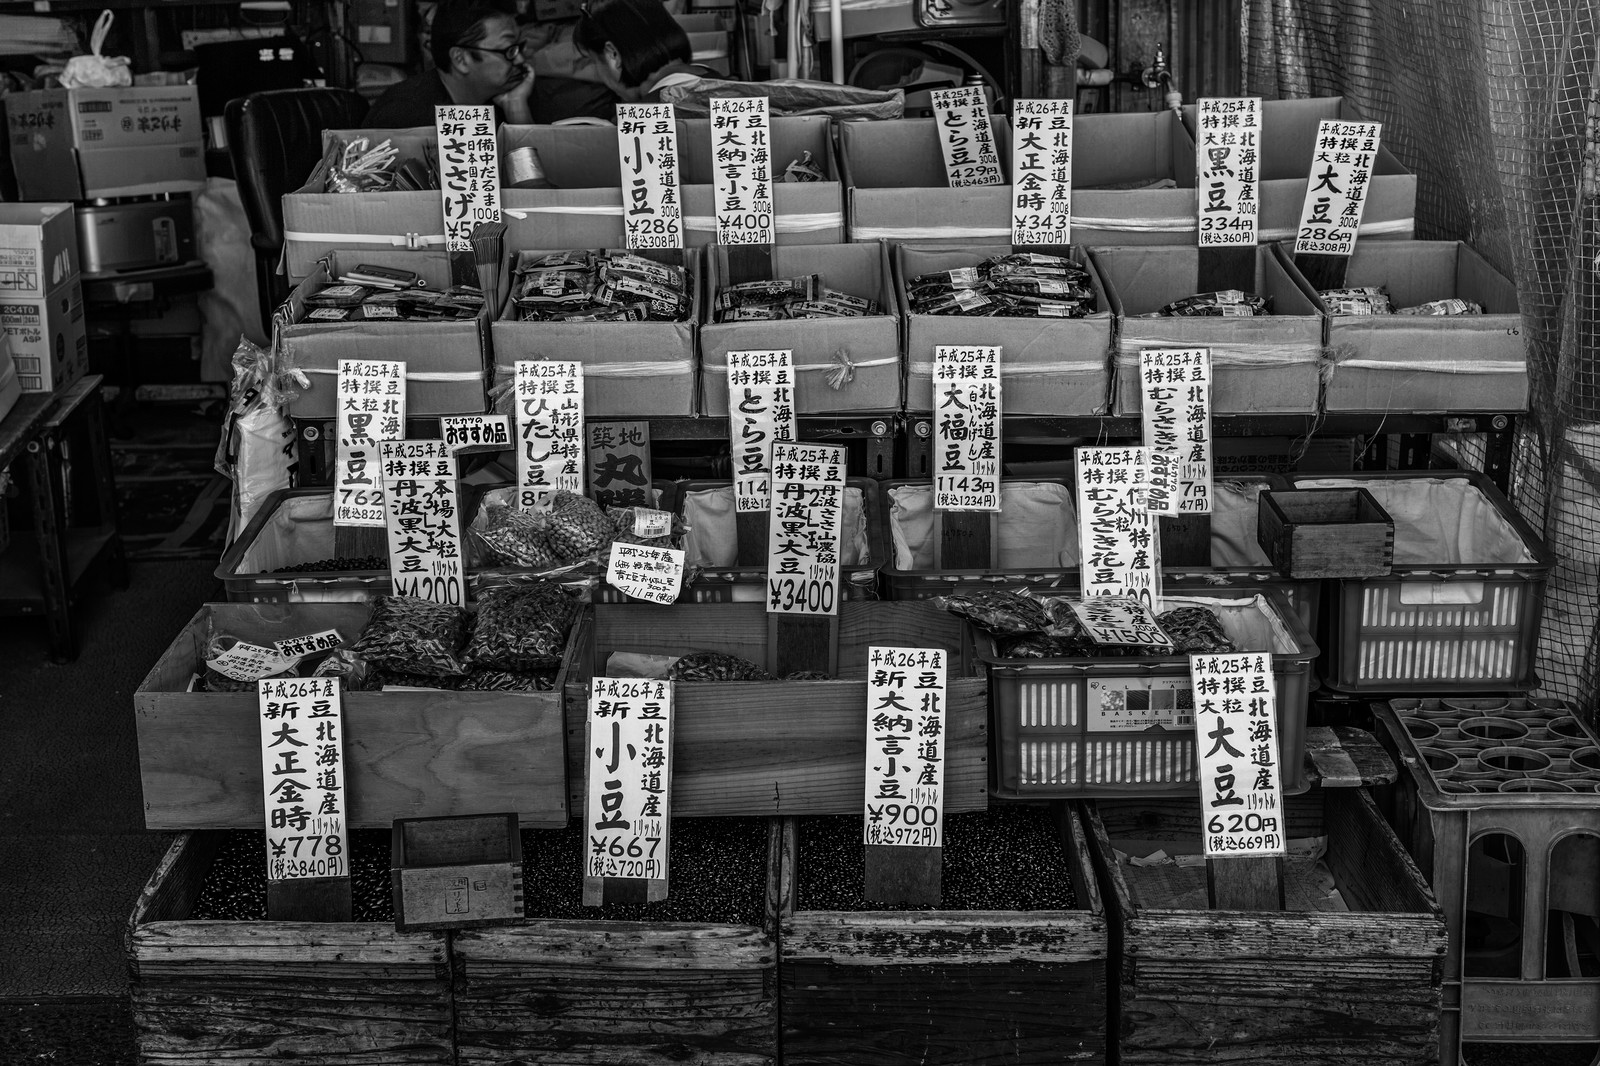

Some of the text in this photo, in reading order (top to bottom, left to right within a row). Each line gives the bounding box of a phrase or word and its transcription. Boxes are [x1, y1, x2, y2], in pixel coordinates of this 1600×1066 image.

[933, 87, 983, 100] 平成25年産
[438, 108, 491, 121] 平成26年産
[619, 106, 671, 119] 平成26年産
[712, 100, 765, 113] 平成26年産
[1016, 102, 1069, 115] 平成26年産
[1202, 100, 1255, 113] 平成25年産
[944, 110, 977, 167] とら豆
[971, 107, 993, 155] 北海道産
[1204, 132, 1237, 146] 大粒
[1321, 123, 1376, 138] 平成25年産
[468, 140, 478, 191] 日本国産
[750, 130, 770, 200] 北海道産
[979, 155, 997, 164] 300g
[1051, 132, 1069, 200] 北海道産
[1237, 132, 1257, 201] 北海道産
[1315, 152, 1351, 163] 大粒
[443, 138, 476, 219] ささげ
[476, 139, 496, 207] 備中だるま
[624, 136, 655, 216] 小豆
[657, 136, 677, 205] 北海道産
[716, 131, 748, 212] 大納言小豆
[951, 166, 997, 178] 429円
[1017, 132, 1047, 211] 大正金時
[1204, 147, 1235, 213] 黒豆
[952, 175, 1000, 188] (税込463円)
[1342, 154, 1370, 216] 北海道産
[1307, 165, 1342, 224] 大豆
[473, 208, 499, 221] 100g
[661, 205, 679, 219] 300g
[753, 200, 771, 214] 300g
[1051, 202, 1068, 215] 300g
[1237, 202, 1256, 215] 300g
[626, 219, 678, 234] ¥286
[718, 214, 770, 229] ¥400
[1015, 215, 1067, 229] ¥343
[1201, 217, 1253, 231] 334円
[1338, 217, 1358, 228] 300g
[628, 234, 679, 249] (税込308円)
[719, 229, 771, 244] (税込432円)
[1014, 229, 1067, 244] (税込370円)
[1200, 231, 1254, 244] (税込360円)
[1299, 228, 1351, 241] 286円
[1297, 240, 1351, 252] (税込308円)
[730, 353, 788, 367] 平成25年産
[938, 349, 996, 363] 平成25年産
[1143, 352, 1203, 366] 平成25年産
[342, 363, 400, 378] 平成25年産
[519, 363, 577, 378] 平成25年産
[344, 397, 379, 412] 大粒
[380, 399, 401, 443] 北海
[738, 388, 771, 475] とら豆
[940, 383, 969, 471] 大福豆
[978, 383, 997, 460] 北海道産
[1186, 386, 1208, 462] 北海道産
[446, 422, 507, 444] おすすめ品
[522, 398, 552, 487] ひたし豆
[549, 409, 564, 455] 青大豆
[560, 397, 580, 474] 山形県特産
[591, 426, 645, 450] 築地
[342, 413, 380, 486] 黒豆
[382, 443, 448, 459] 平成25年産
[775, 447, 841, 464] 平成25年産
[1080, 450, 1144, 466] 平成25年産
[938, 477, 994, 493] 1143円
[1148, 454, 1174, 510] おすすめ品
[937, 494, 996, 507] (税込1234円)
[389, 479, 431, 573] 丹波黒大豆
[432, 480, 459, 560] 本場大粒
[1116, 499, 1130, 532] 大粒
[774, 483, 810, 575] 丹波黒大豆
[1086, 488, 1124, 584] むらさき花豆
[1126, 488, 1150, 570] 信州特産
[770, 579, 833, 612] ¥3400
[281, 633, 341, 656] おすすめ品
[1093, 628, 1168, 644] ¥1500
[871, 649, 941, 669] 平成26年産
[1195, 656, 1265, 675] 平成25年産
[261, 680, 334, 699] 平成26年産
[594, 680, 666, 699] 平成26年産
[1199, 699, 1244, 714] 大粒
[872, 691, 913, 799] 大納言小豆
[917, 692, 942, 785] 北海道産
[1248, 697, 1275, 790] 北海道産
[315, 721, 341, 815] 北海道産
[640, 723, 666, 817] 北海道産
[1204, 716, 1245, 807] 大豆
[268, 722, 312, 831] 大正金時
[595, 722, 636, 830] 小豆
[868, 804, 938, 826] ¥900
[1208, 813, 1277, 833] 620円
[866, 825, 937, 845] (税込972円)
[1209, 834, 1280, 851] (税込669円)
[269, 835, 341, 858] ¥778
[590, 836, 661, 858] ¥667
[270, 858, 343, 880] (税込840円)
[589, 856, 661, 878] (税込720円)
